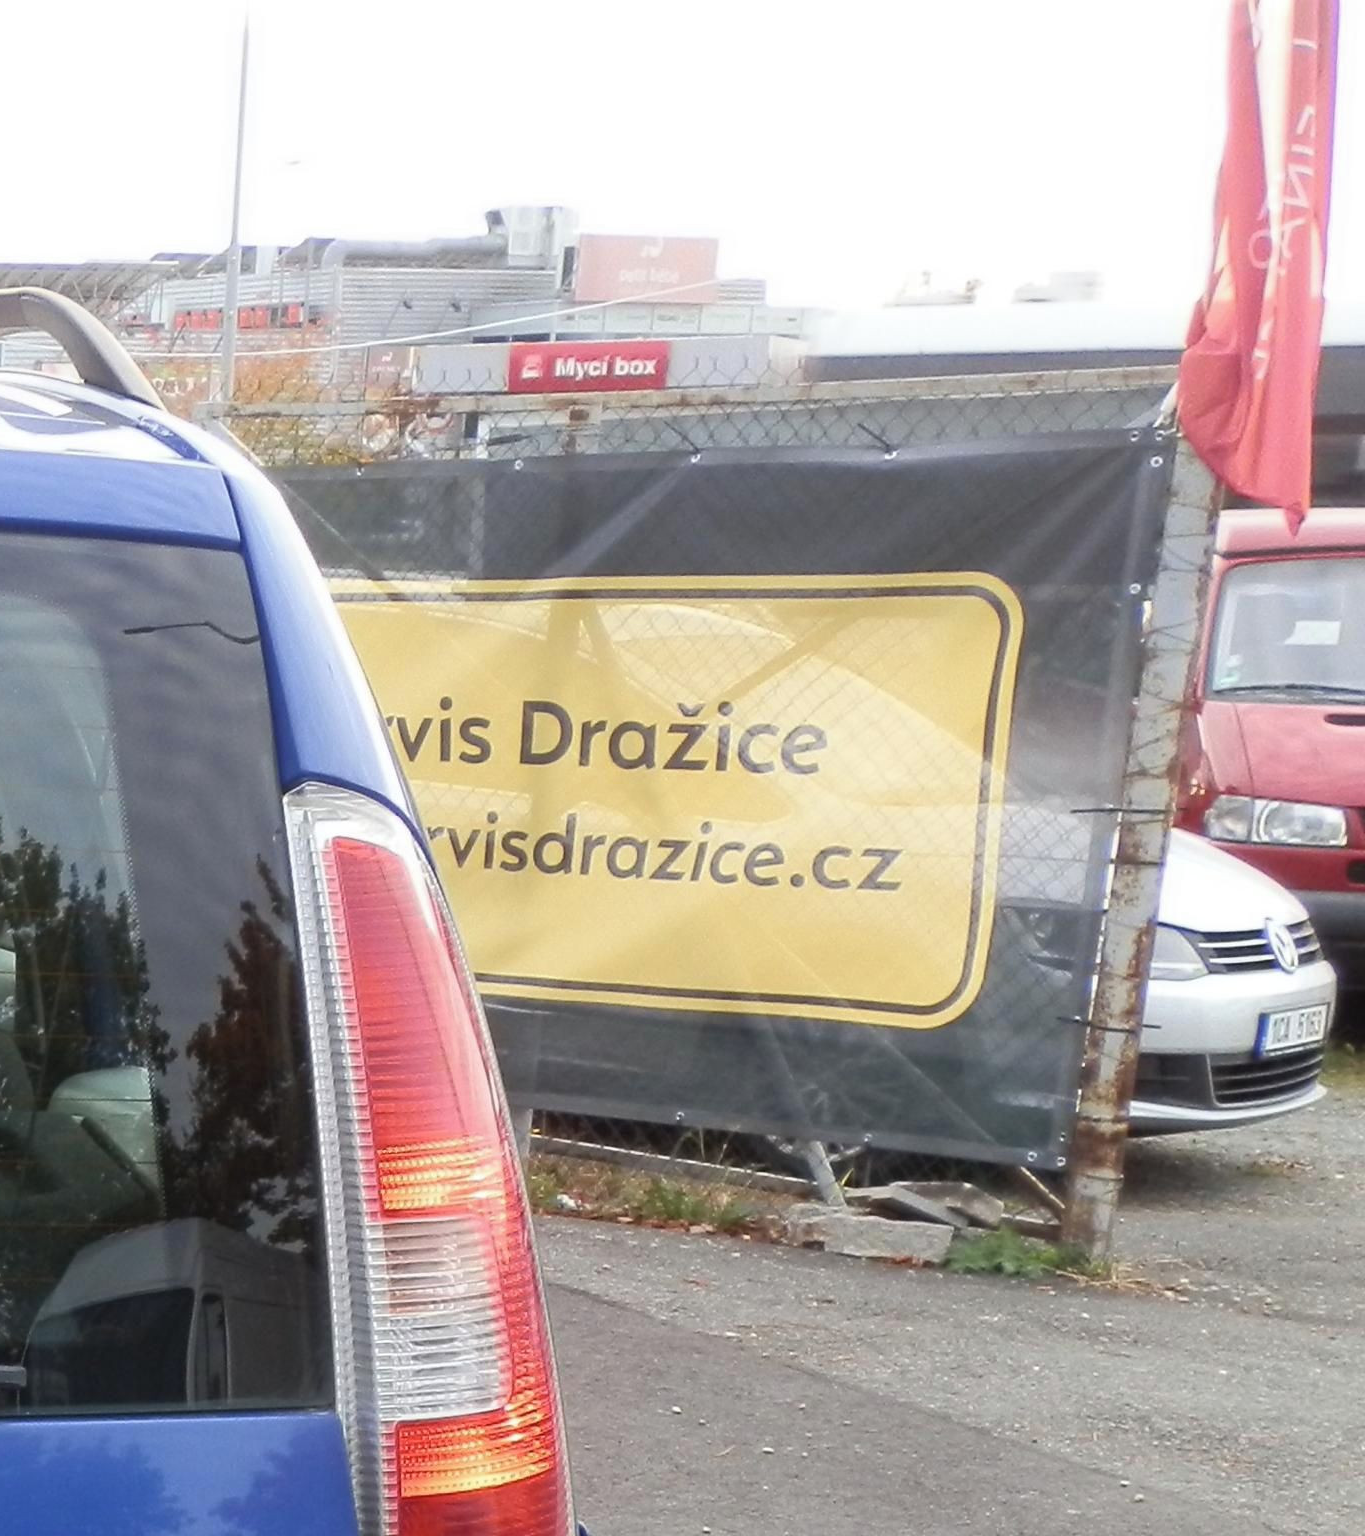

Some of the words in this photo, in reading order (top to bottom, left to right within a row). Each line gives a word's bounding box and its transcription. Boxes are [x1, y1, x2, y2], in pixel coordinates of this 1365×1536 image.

[554, 354, 609, 381] Mycí
[614, 355, 657, 376] box
[385, 696, 492, 765] vis
[518, 700, 828, 776] Dražice
